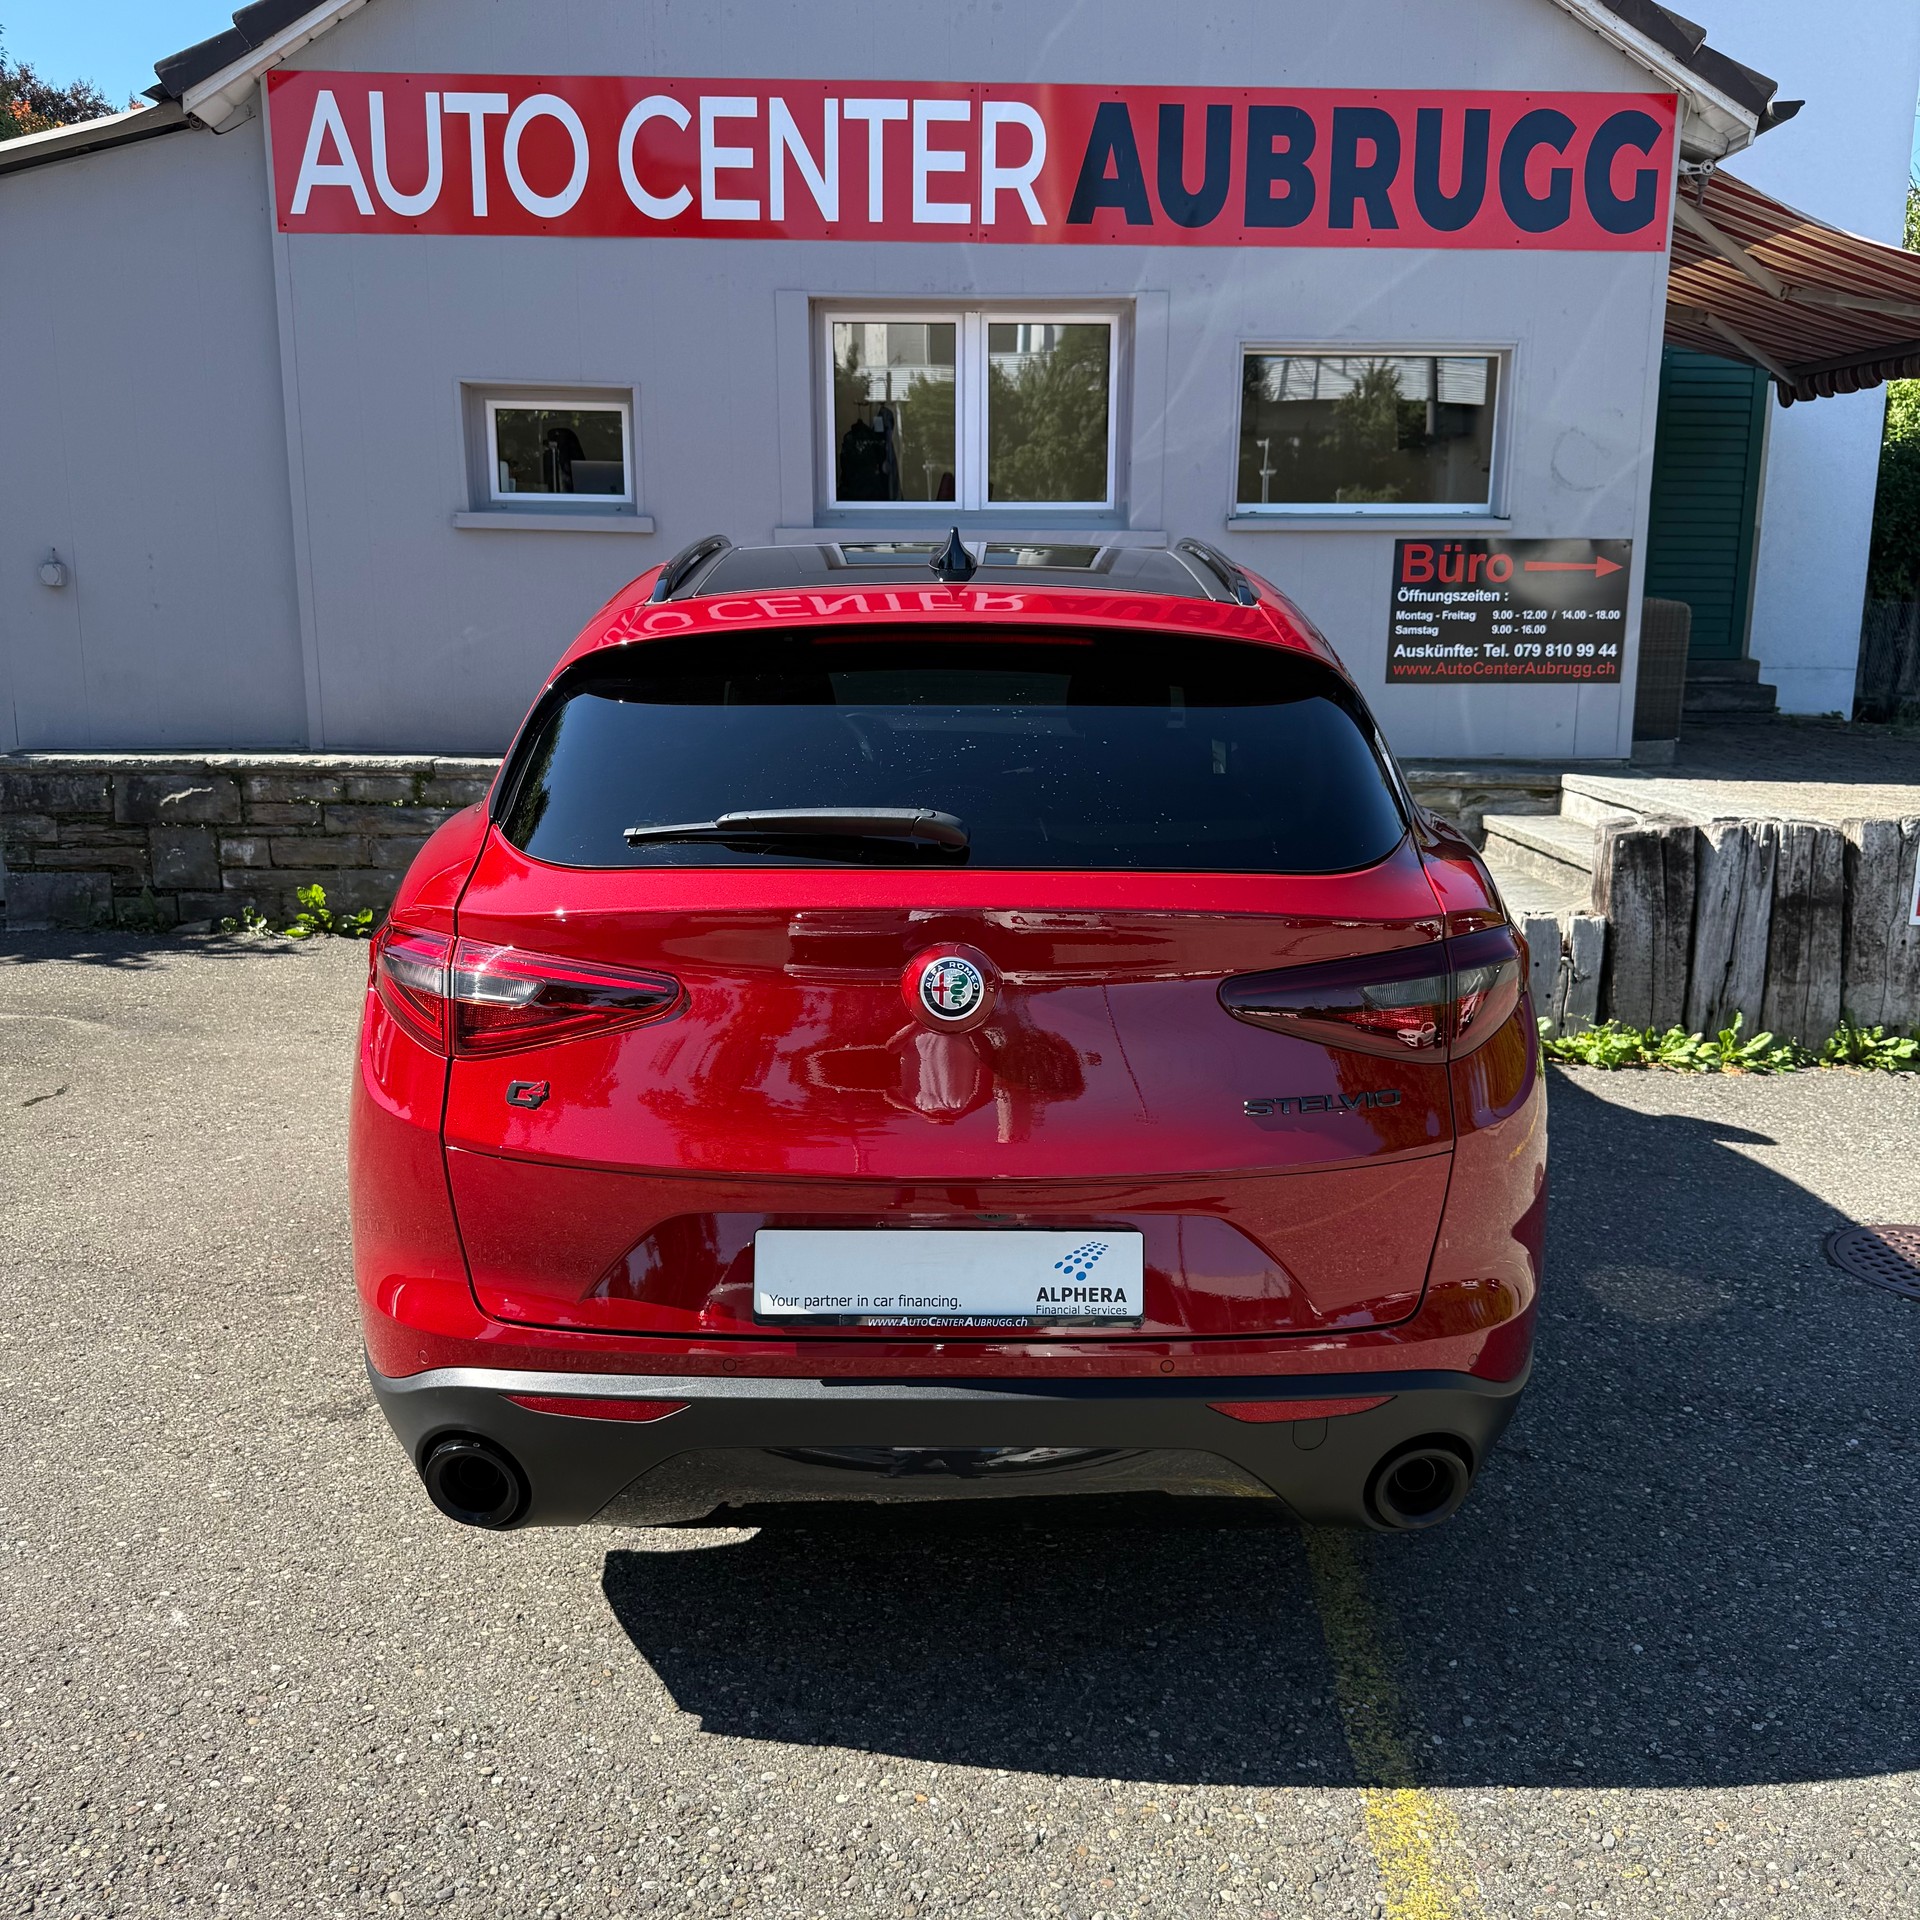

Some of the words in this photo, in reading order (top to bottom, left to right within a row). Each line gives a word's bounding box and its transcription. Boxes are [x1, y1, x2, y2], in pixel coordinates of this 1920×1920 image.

[290, 90, 589, 218] AUTO
[618, 94, 1048, 226] CENTER
[1065, 101, 1663, 235] AUBRUGG
[1402, 543, 1514, 583] Büro
[1397, 586, 1500, 604] Öffnungszeiten
[1395, 610, 1433, 622] Montag
[1441, 610, 1477, 622] Freitag
[1492, 610, 1513, 620] 9.00
[1522, 610, 1547, 620] 12.00
[1561, 610, 1587, 620] 14.00
[1595, 610, 1621, 620] 18.00
[1395, 625, 1439, 637] Samstag
[1491, 624, 1513, 634] 9.00
[1521, 624, 1546, 634] 16.00
[1393, 643, 1479, 658] Auskünfte:
[1483, 643, 1510, 657] Tel.
[1513, 643, 1541, 657] 079
[1545, 643, 1572, 657] 810
[1576, 643, 1595, 657] 99
[1598, 643, 1618, 657] 44
[1393, 661, 1615, 678] www.AutoCenterAubrugg.ch
[925, 964, 945, 989] ALFA
[949, 961, 979, 990] ROMEO
[1243, 1089, 1401, 1116] STELVIO
[770, 1295, 799, 1308] Your
[804, 1296, 853, 1309] partner
[857, 1295, 869, 1307] in
[873, 1297, 894, 1307] car
[898, 1295, 962, 1310] financing.
[1036, 1286, 1127, 1303] ALPHERA
[1035, 1305, 1080, 1315] Financial
[1084, 1305, 1128, 1315] Services
